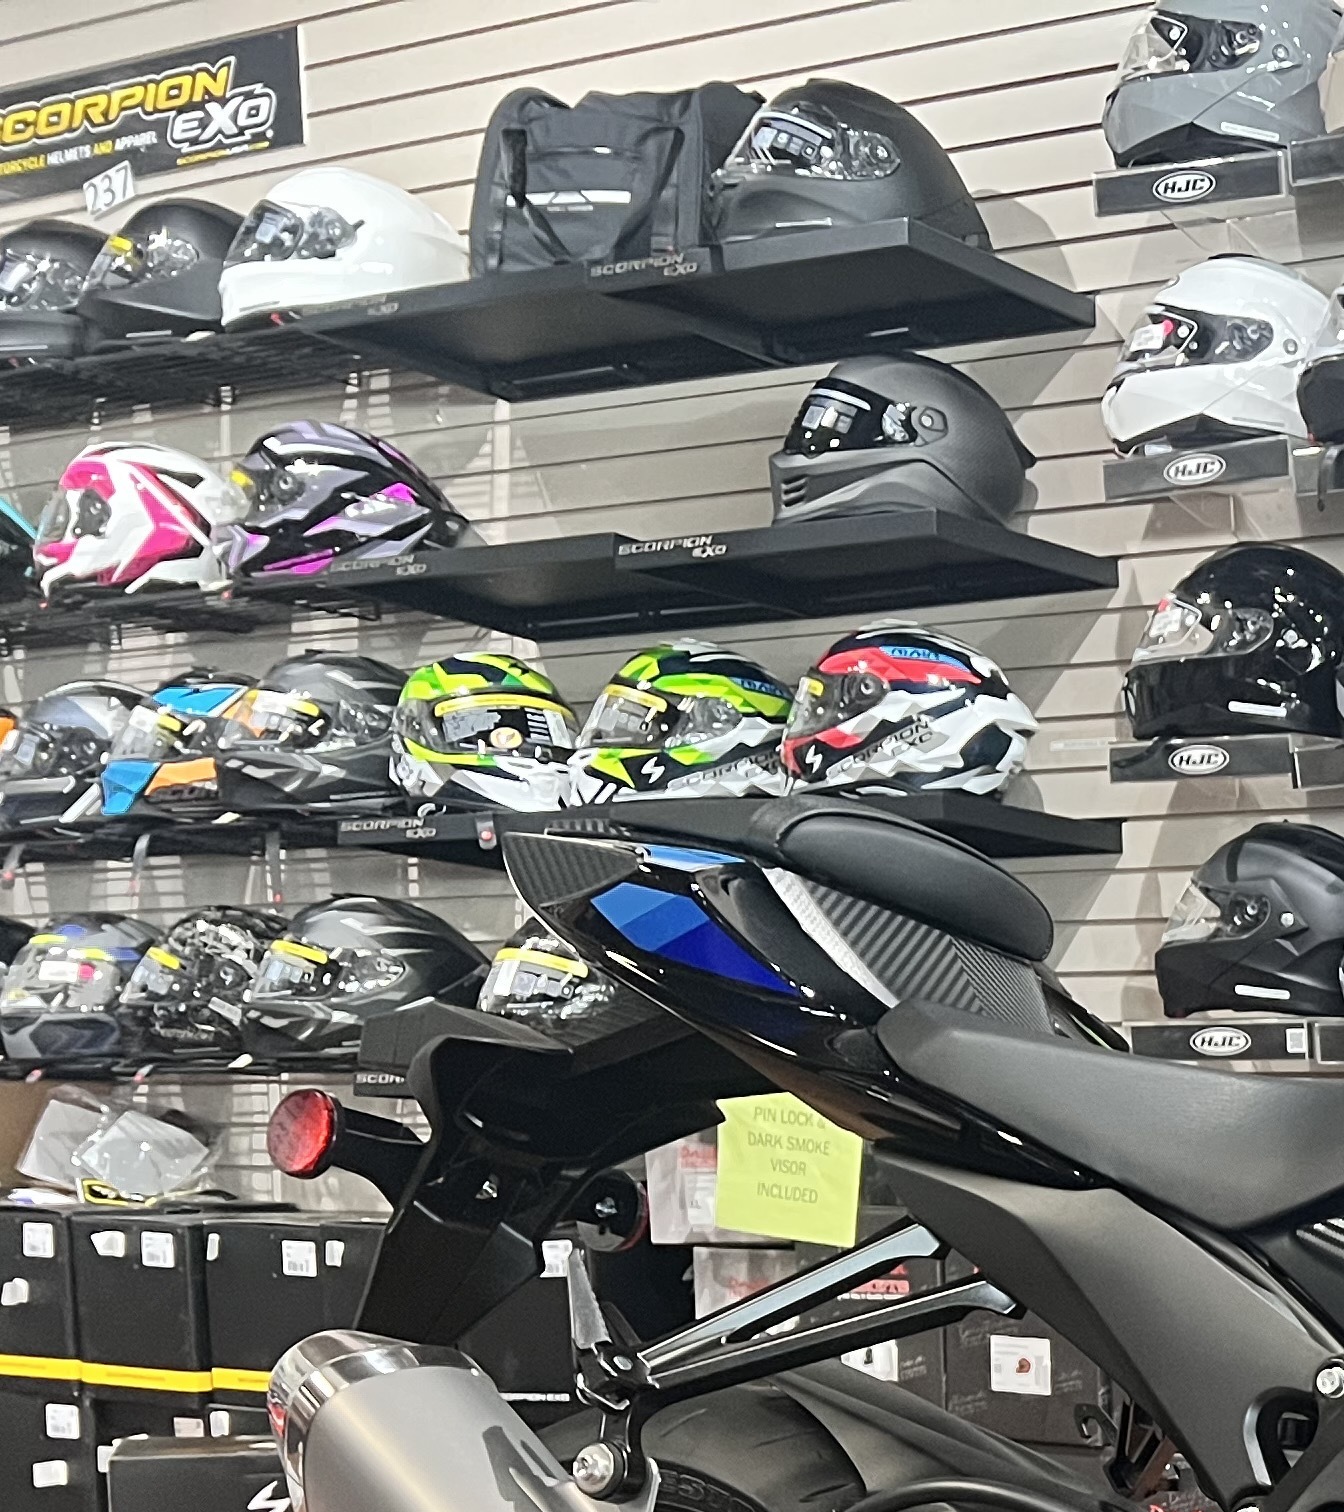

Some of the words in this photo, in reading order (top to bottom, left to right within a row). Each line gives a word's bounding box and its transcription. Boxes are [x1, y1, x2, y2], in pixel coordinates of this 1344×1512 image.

[0, 65, 230, 144] CORPION
[85, 165, 131, 211] 237
[1163, 178, 1205, 195] HJC
[589, 253, 685, 276] SCORPION
[1174, 461, 1215, 477] HJC
[618, 535, 714, 556] SCORPION
[1178, 753, 1218, 767] HJC
[340, 818, 426, 833] SCORPION
[1200, 1036, 1240, 1049] HJC
[753, 1106, 777, 1123] PIN
[781, 1109, 814, 1128] LOCK
[747, 1131, 783, 1150] DARK
[786, 1136, 831, 1157] SMOKE
[770, 1157, 807, 1177] VISOR
[756, 1181, 820, 1205] INCLUDED
